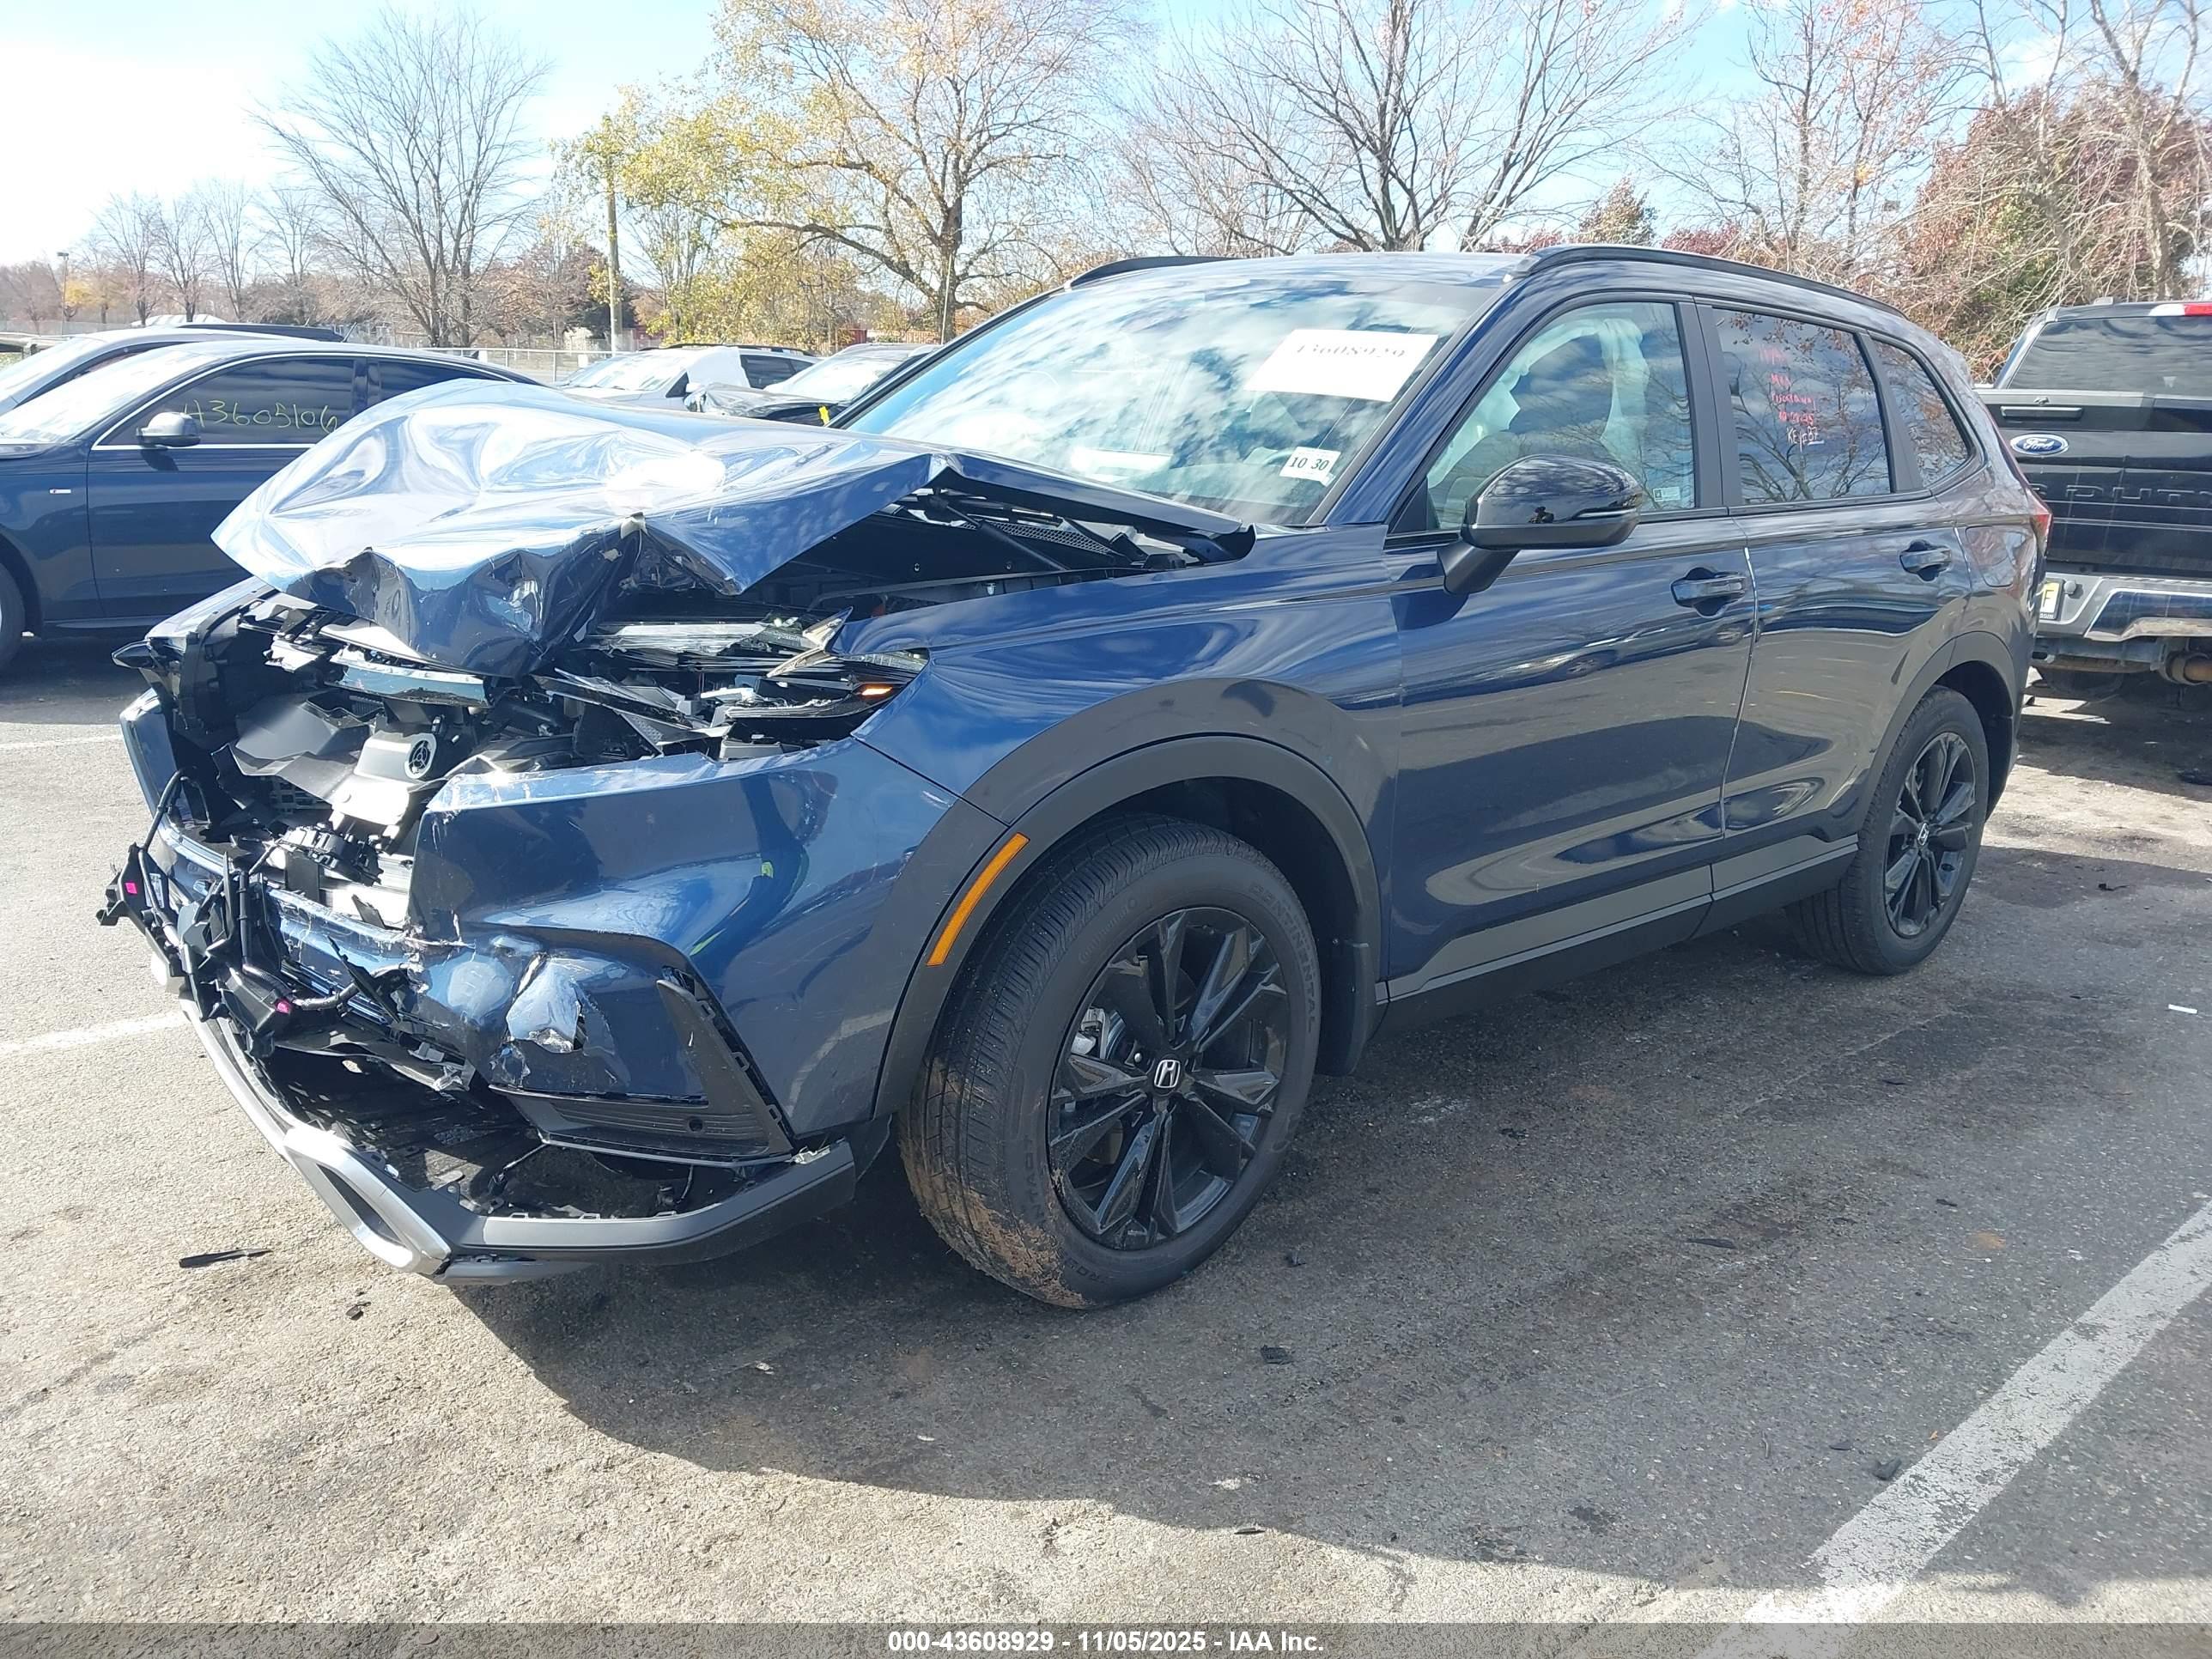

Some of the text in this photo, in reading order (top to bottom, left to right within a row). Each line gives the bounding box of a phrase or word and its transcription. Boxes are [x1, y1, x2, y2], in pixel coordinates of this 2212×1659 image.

[184, 399, 337, 434] 43605106
[1290, 457, 1330, 471] 10 30
